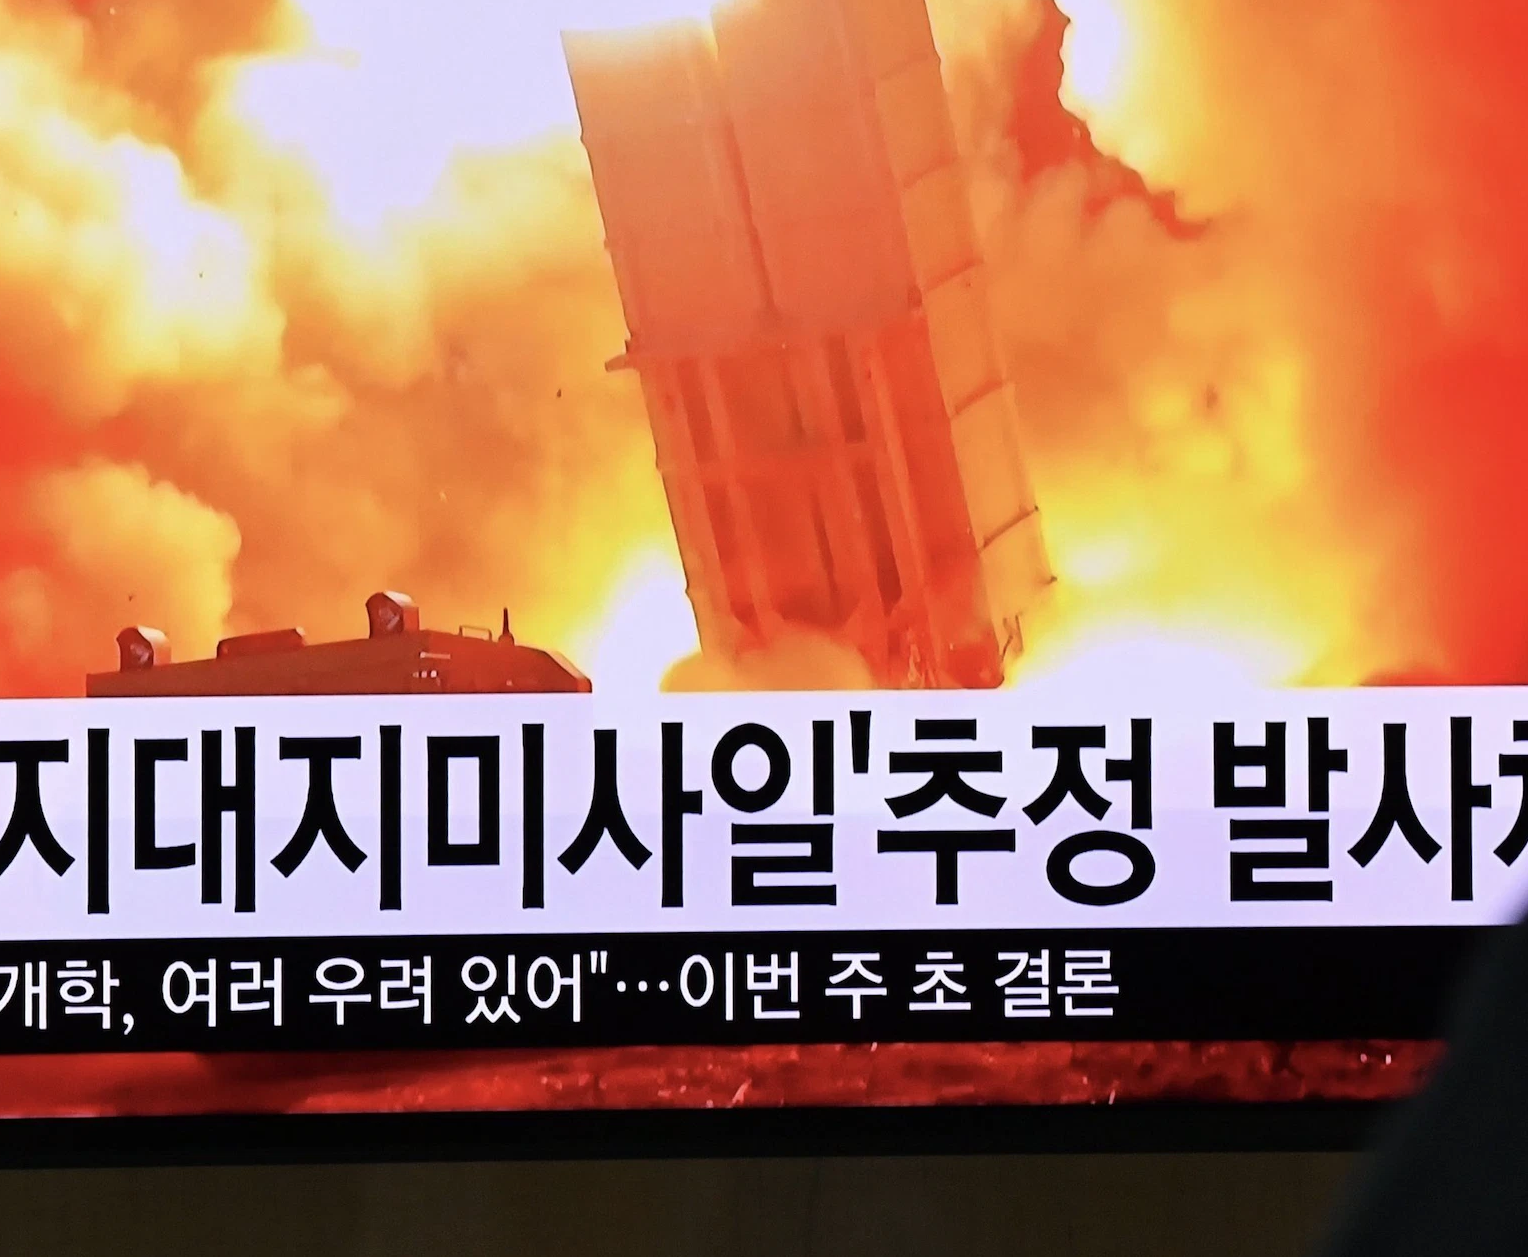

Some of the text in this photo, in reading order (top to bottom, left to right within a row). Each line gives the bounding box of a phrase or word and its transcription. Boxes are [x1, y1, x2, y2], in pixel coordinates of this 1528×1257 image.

[162, 957, 283, 1028] 여러
[308, 955, 432, 1026] 우려
[824, 952, 888, 1020] 주
[908, 951, 972, 1011] 초
[994, 949, 1120, 1018] 결론
